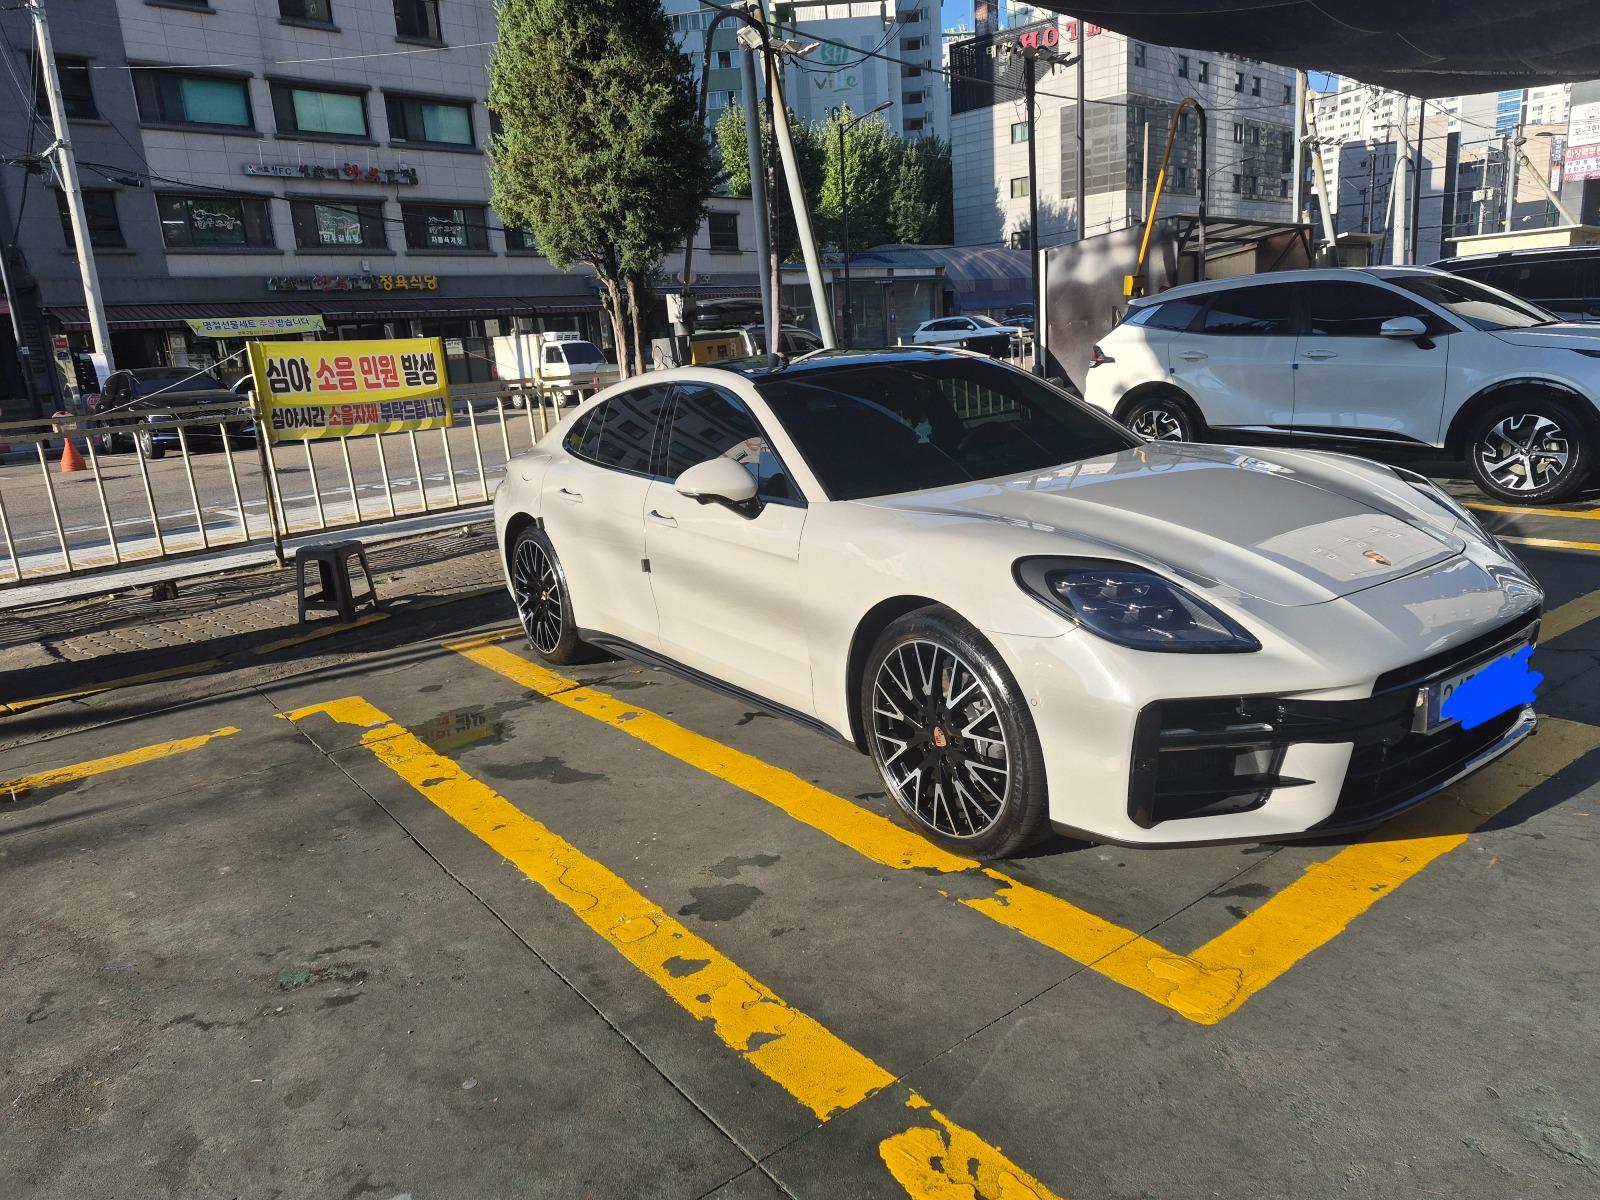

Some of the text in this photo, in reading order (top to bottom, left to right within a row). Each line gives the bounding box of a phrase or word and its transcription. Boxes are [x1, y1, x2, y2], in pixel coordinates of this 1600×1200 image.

[379, 274, 438, 291] 정육식당
[202, 319, 257, 331] 명절선물세트
[266, 352, 438, 393] 심야 소음 민원 발생
[271, 397, 447, 429] 심야시간 소음자제 부탁드립니다
